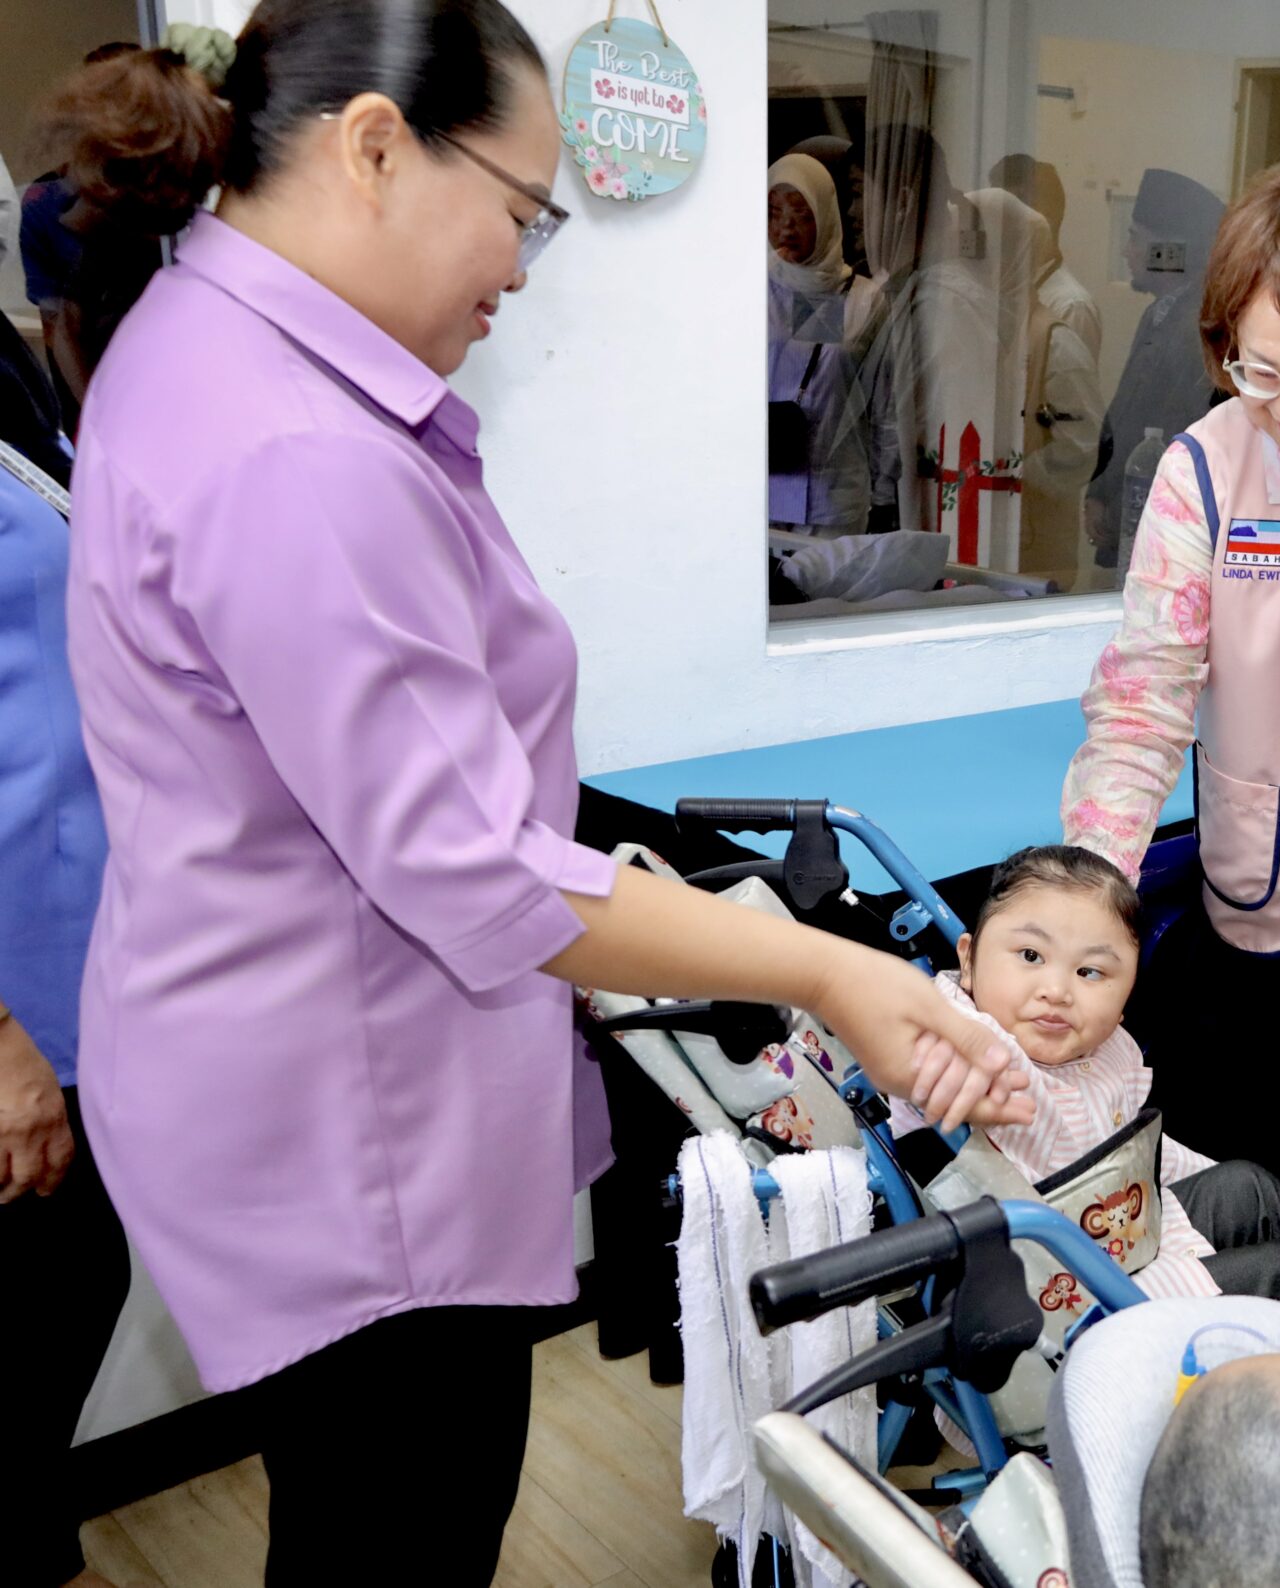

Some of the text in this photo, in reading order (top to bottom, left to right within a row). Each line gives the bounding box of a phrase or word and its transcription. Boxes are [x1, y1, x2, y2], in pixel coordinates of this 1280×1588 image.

[589, 39, 690, 87] The Best
[617, 81, 665, 109] is yet to
[591, 108, 690, 162] COME
[1231, 554, 1280, 563] SABAH
[1222, 568, 1253, 579] LINDA
